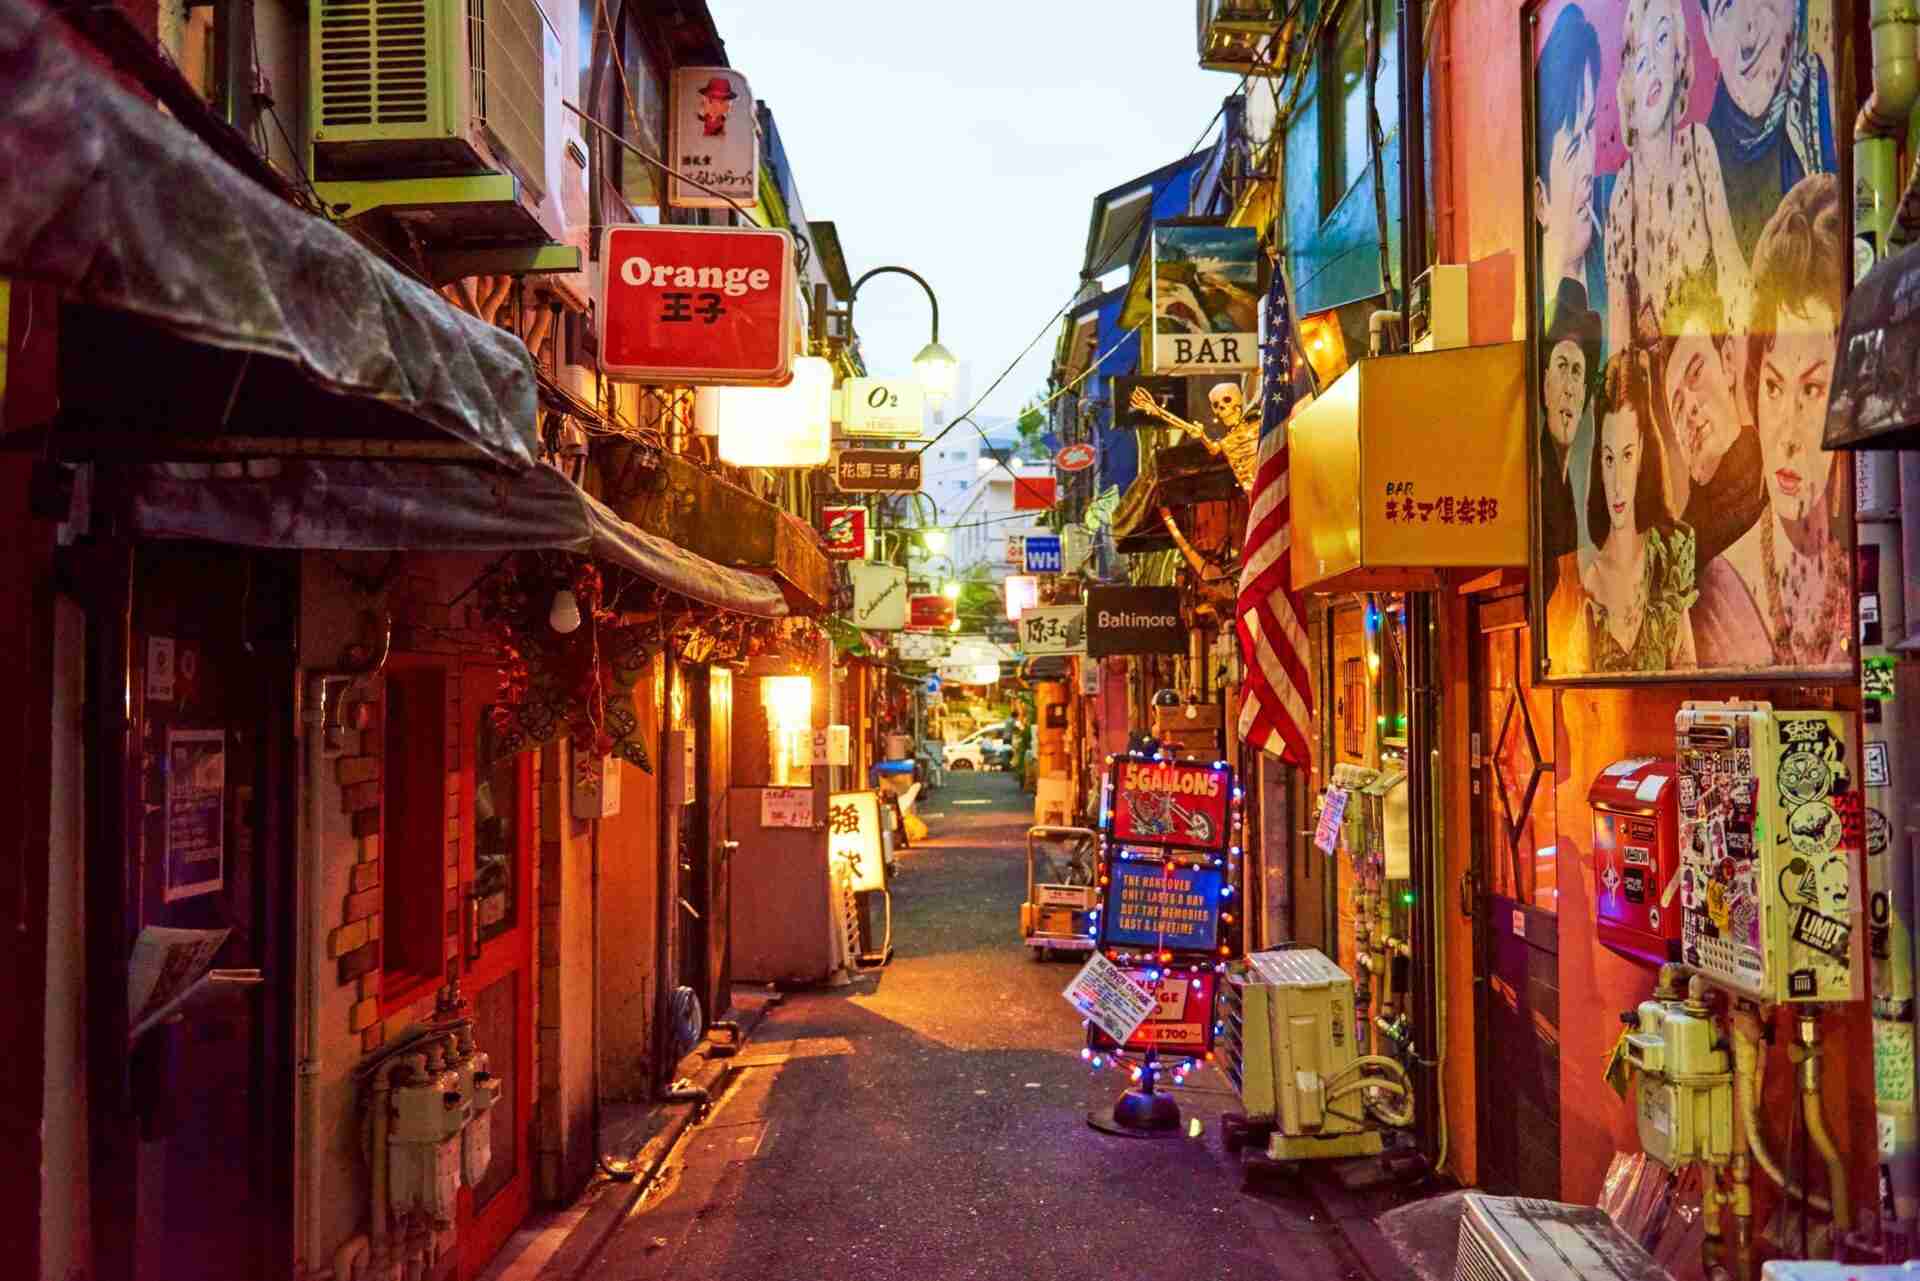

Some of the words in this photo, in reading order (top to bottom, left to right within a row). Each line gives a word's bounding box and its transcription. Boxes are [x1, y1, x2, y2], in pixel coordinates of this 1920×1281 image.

[620, 256, 770, 296] Orange
[660, 291, 727, 324] 王子
[1175, 338, 1240, 364] BAR
[839, 462, 920, 481] 花園三番街
[1385, 481, 1415, 496] BAR
[1098, 610, 1176, 629] Baltimore
[1123, 874, 1140, 888] THE
[1161, 906, 1209, 922] MEMORIES
[1119, 917, 1143, 931] LAST
[1106, 967, 1128, 985] COVER
